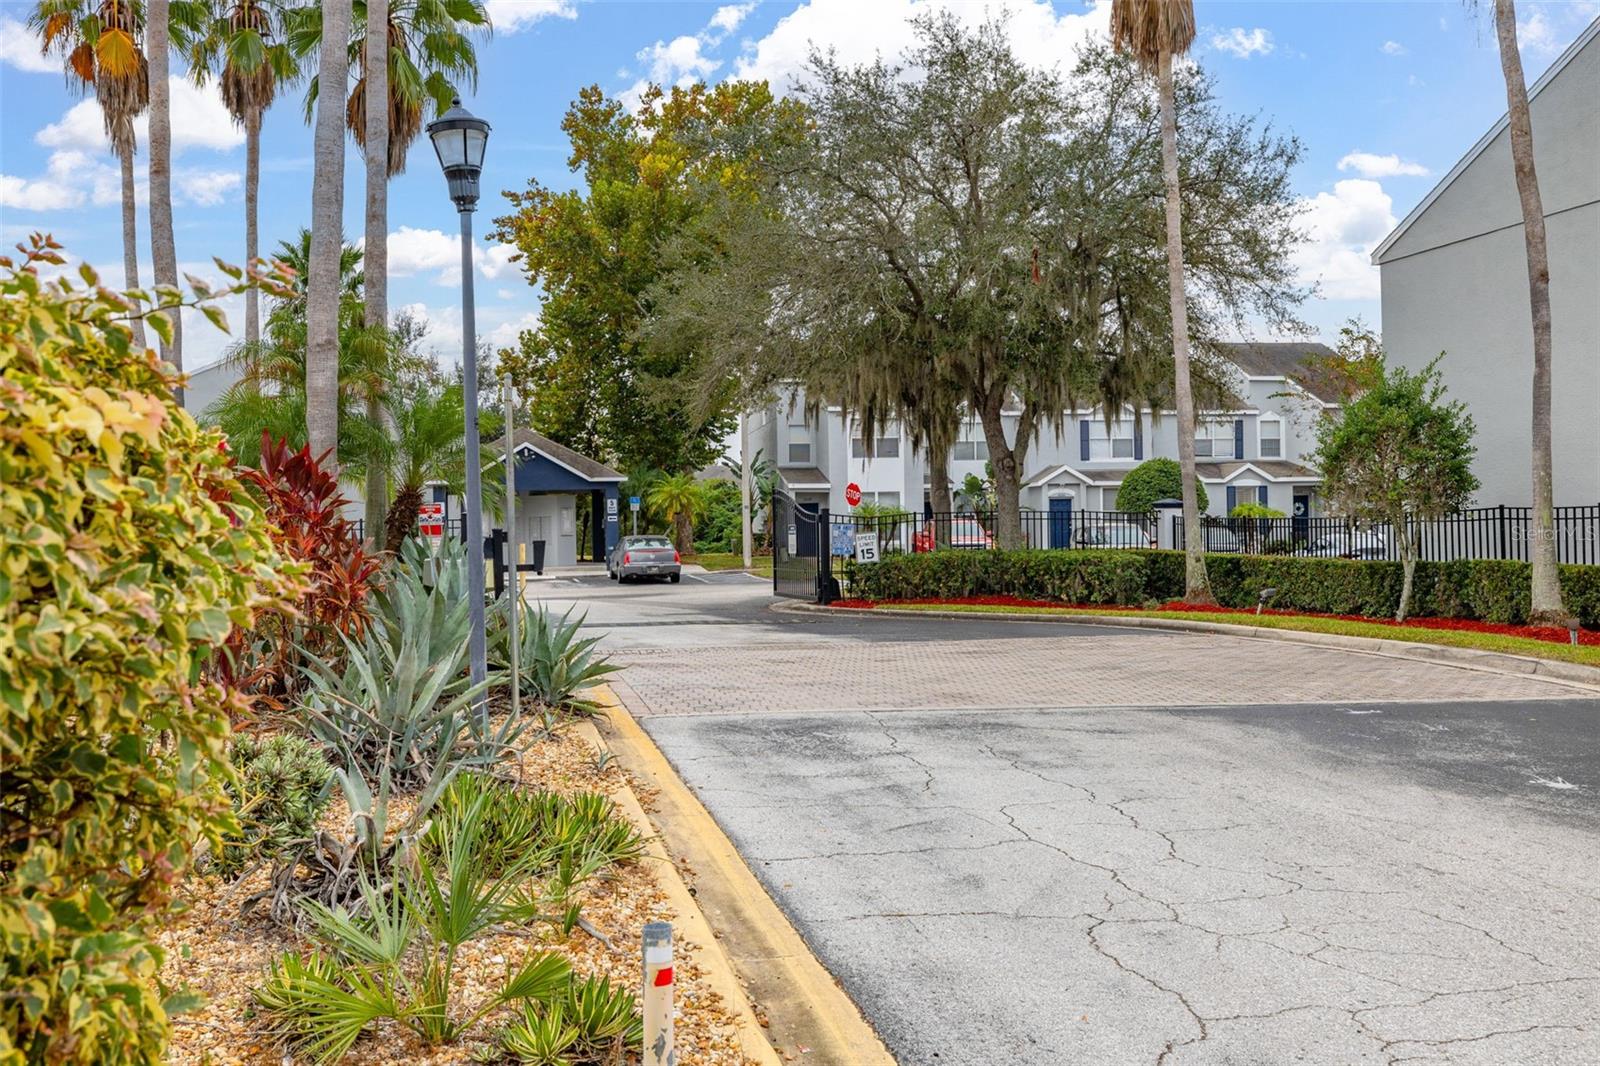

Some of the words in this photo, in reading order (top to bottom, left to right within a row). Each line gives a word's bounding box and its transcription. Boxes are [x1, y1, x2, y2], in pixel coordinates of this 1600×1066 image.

[846, 489, 861, 500] STOP
[857, 534, 875, 542] SPEED
[861, 548, 875, 560] 15
